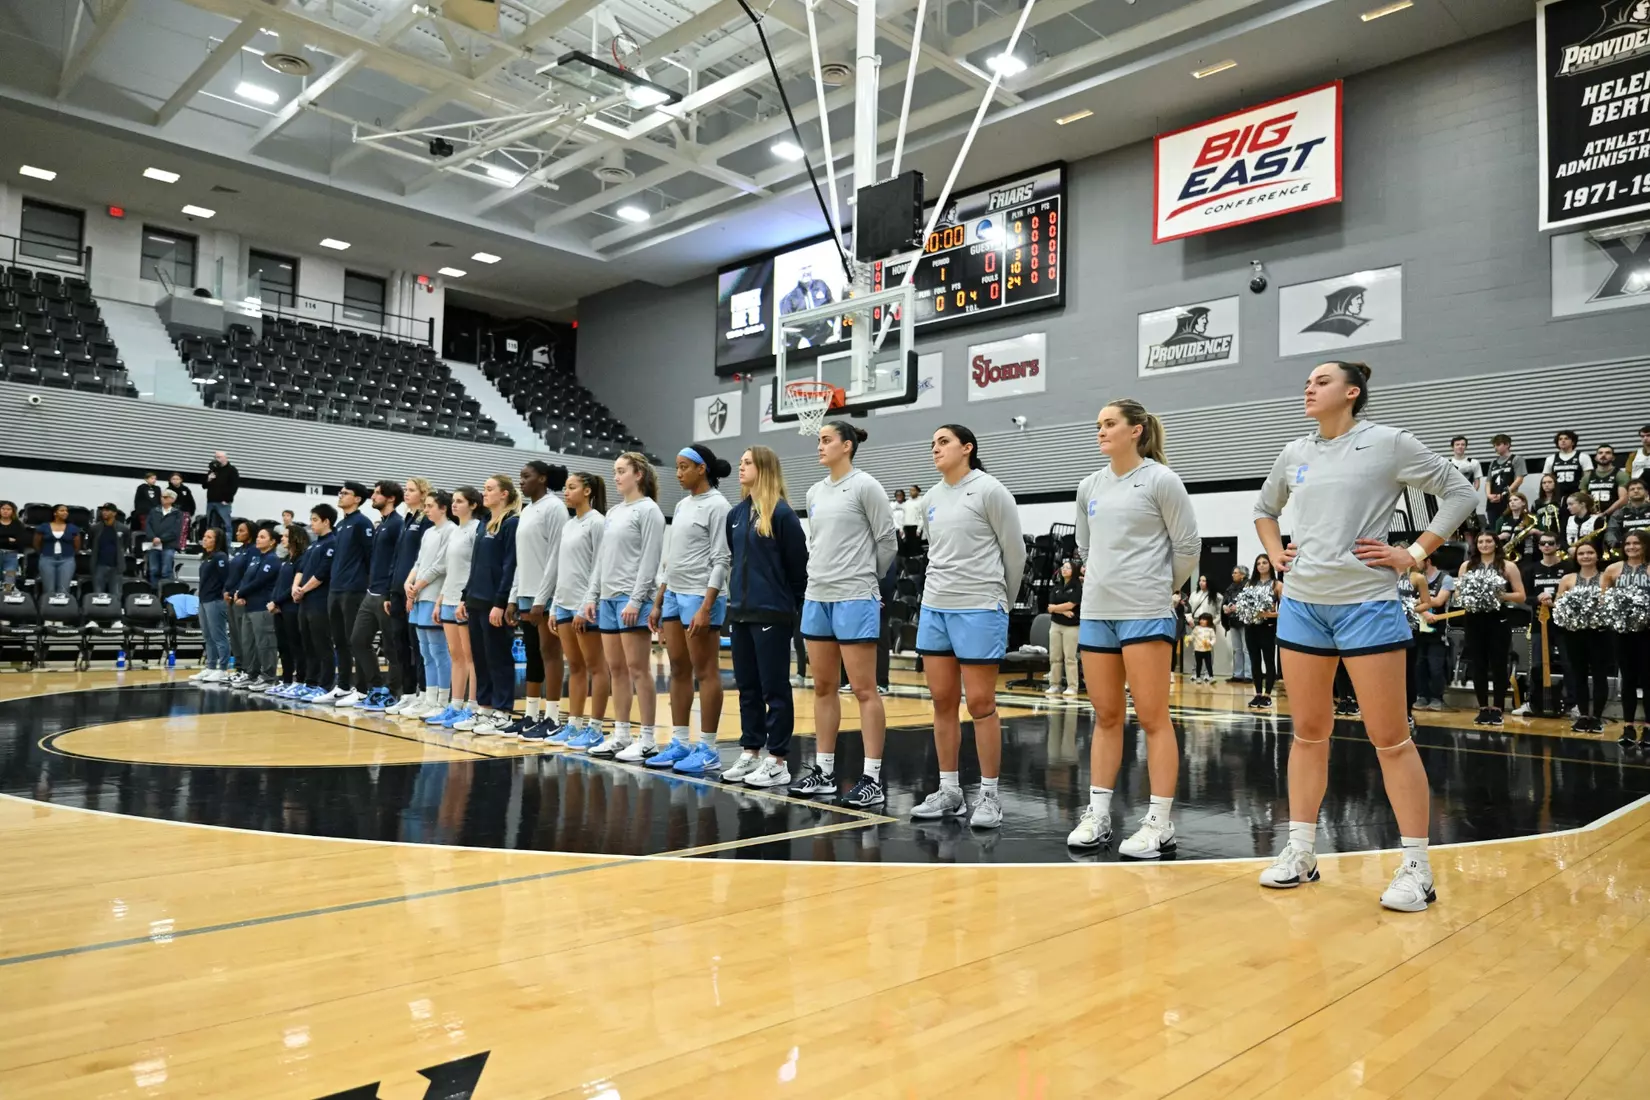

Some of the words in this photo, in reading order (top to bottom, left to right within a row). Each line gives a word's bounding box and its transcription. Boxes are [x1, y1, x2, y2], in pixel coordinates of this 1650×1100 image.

[1193, 111, 1298, 168] BIG
[1177, 136, 1327, 201] EAST
[988, 183, 1034, 211] FRIARS
[1204, 182, 1311, 216] CONFERENCE
[1031, 216, 1039, 229] 0
[1049, 211, 1057, 224] 0
[1031, 229, 1039, 242] 0
[1048, 225, 1057, 238] 0
[1031, 243, 1039, 256] 0
[1048, 239, 1057, 252] 0
[932, 256, 950, 268] PERIOD
[985, 252, 996, 273] 0
[1031, 256, 1039, 269] 0
[1048, 252, 1057, 265] 0
[941, 267, 945, 281] 1
[981, 274, 999, 285] FOULS
[1007, 276, 1022, 290] 24
[1031, 270, 1039, 284] 0
[1048, 266, 1057, 280] 0
[956, 290, 966, 307] 0
[990, 282, 999, 300] 0
[935, 295, 945, 312] 0
[1147, 336, 1231, 367] PROVIDENCE
[1556, 471, 1575, 483] 35
